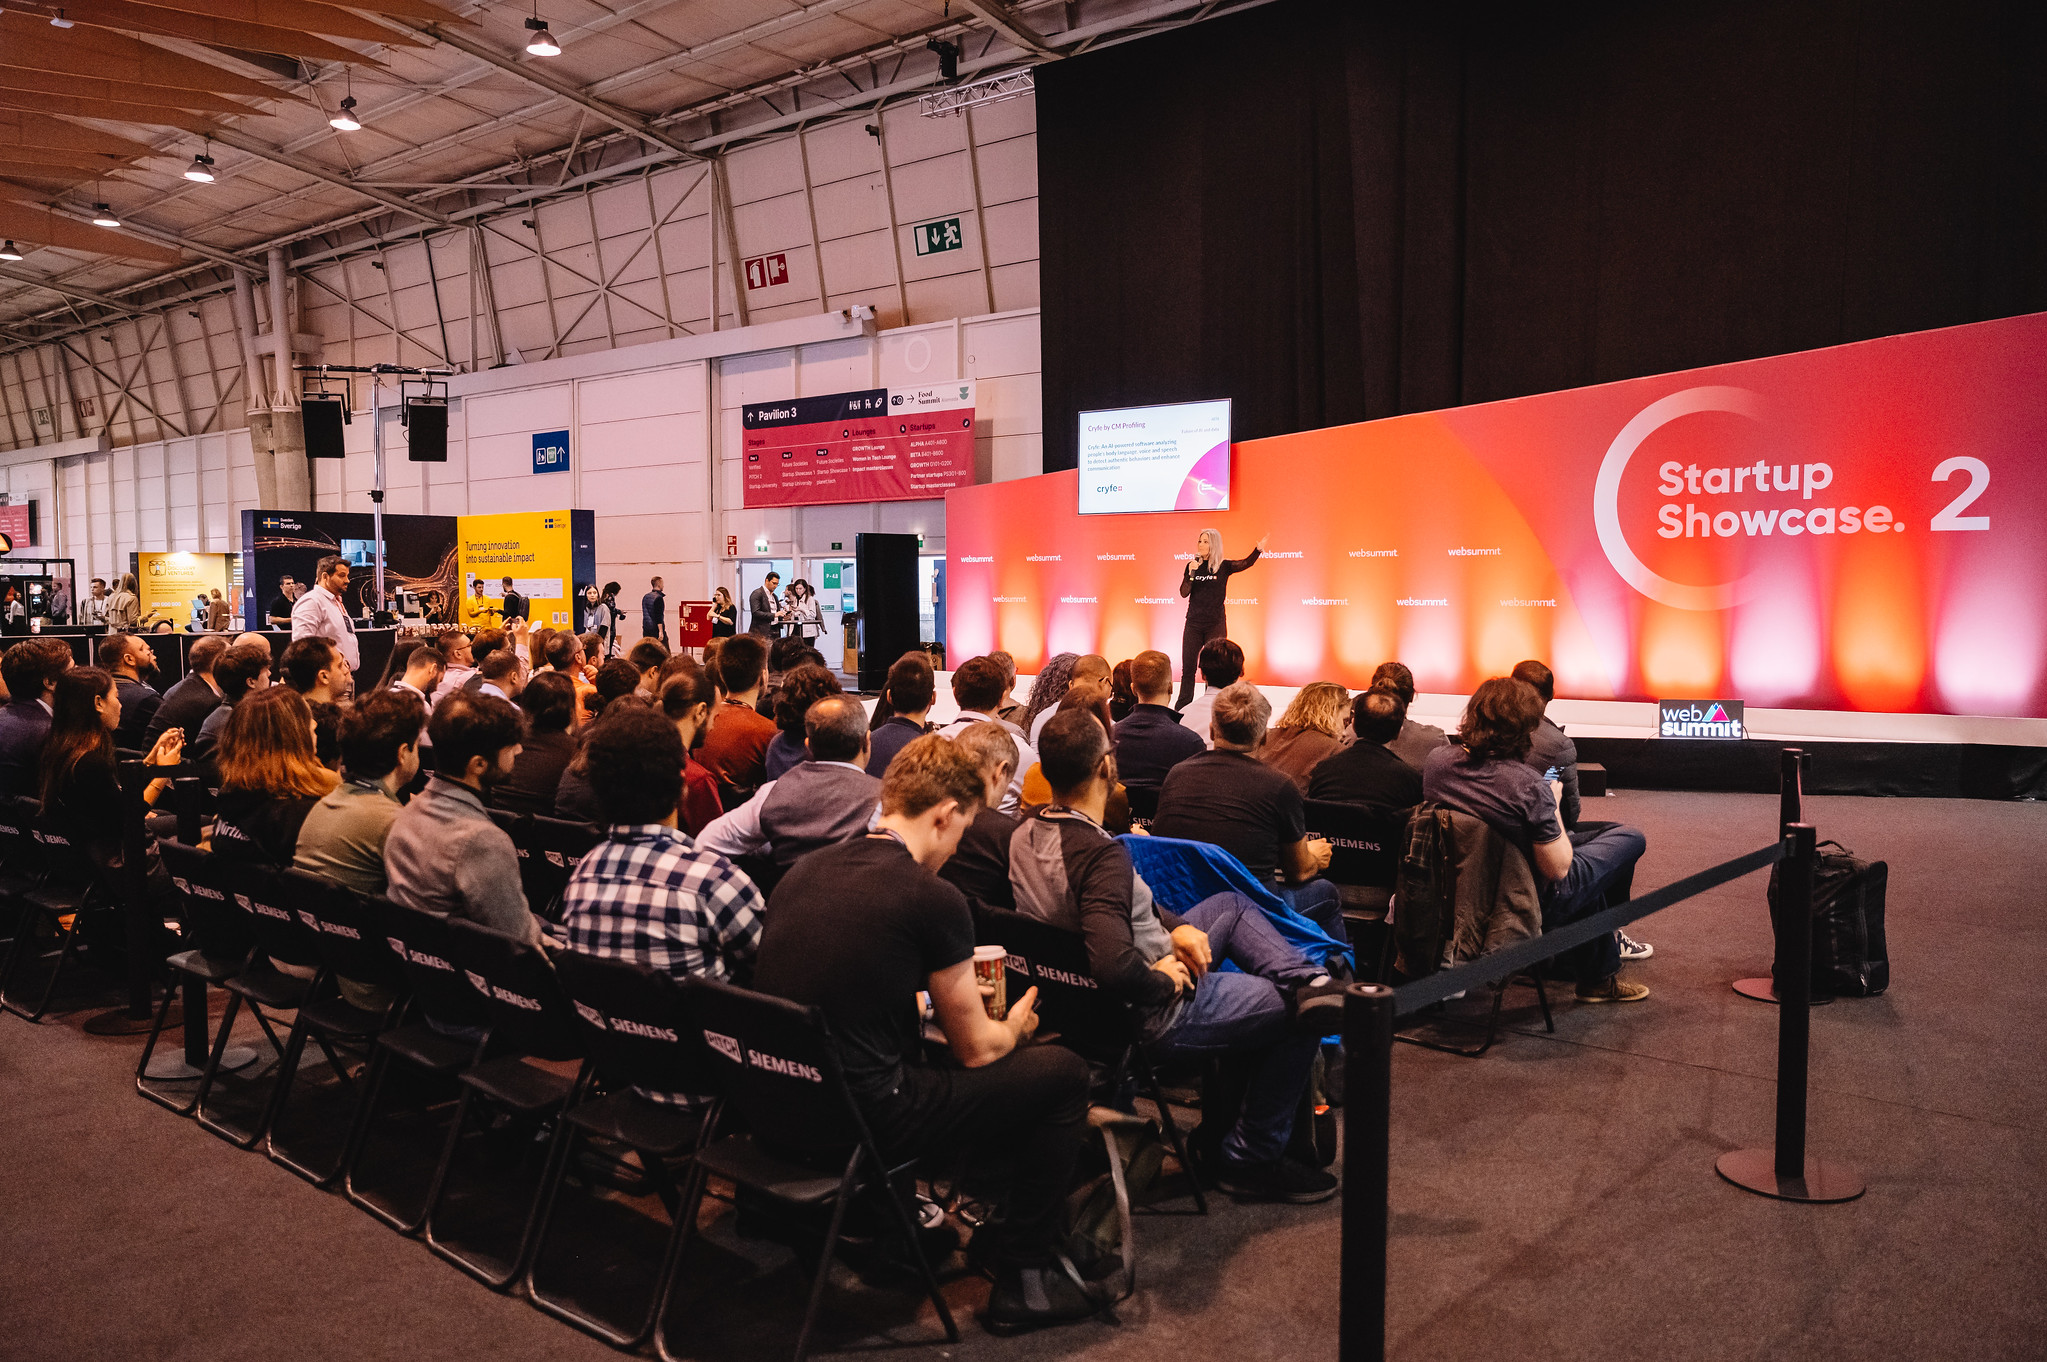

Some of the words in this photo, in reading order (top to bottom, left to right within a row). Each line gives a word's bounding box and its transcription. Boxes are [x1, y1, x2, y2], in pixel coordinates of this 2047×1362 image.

[918, 397, 941, 405] Summit
[919, 390, 933, 398] Food
[758, 408, 790, 421] Pavilion
[791, 406, 797, 418] 3
[852, 428, 876, 437] Lounges
[910, 423, 936, 432] Startups
[1122, 422, 1146, 430] Profiling
[1658, 459, 1833, 499] Startup
[1097, 483, 1118, 494] cryfe
[1930, 456, 1991, 532] 2
[280, 522, 301, 530] Sverige
[1656, 504, 1905, 539] Showcase.
[465, 540, 487, 553] Turning
[488, 540, 520, 551] innovation
[466, 554, 477, 563] into
[478, 552, 512, 563] sustainable
[513, 552, 535, 564] impact
[1662, 704, 1702, 722] web
[1661, 719, 1741, 737] summit
[1329, 837, 1381, 851] SIEMENS
[191, 883, 225, 900] SIEMENS
[254, 902, 291, 921] SIEMENS
[320, 920, 361, 939] SIEMENS
[1036, 964, 1098, 989] SIEMENS
[492, 985, 542, 1011] SIEMENS
[609, 1017, 679, 1043] SIEMENS
[707, 1032, 741, 1061] PITCH
[748, 1049, 823, 1083] SIEMENS
